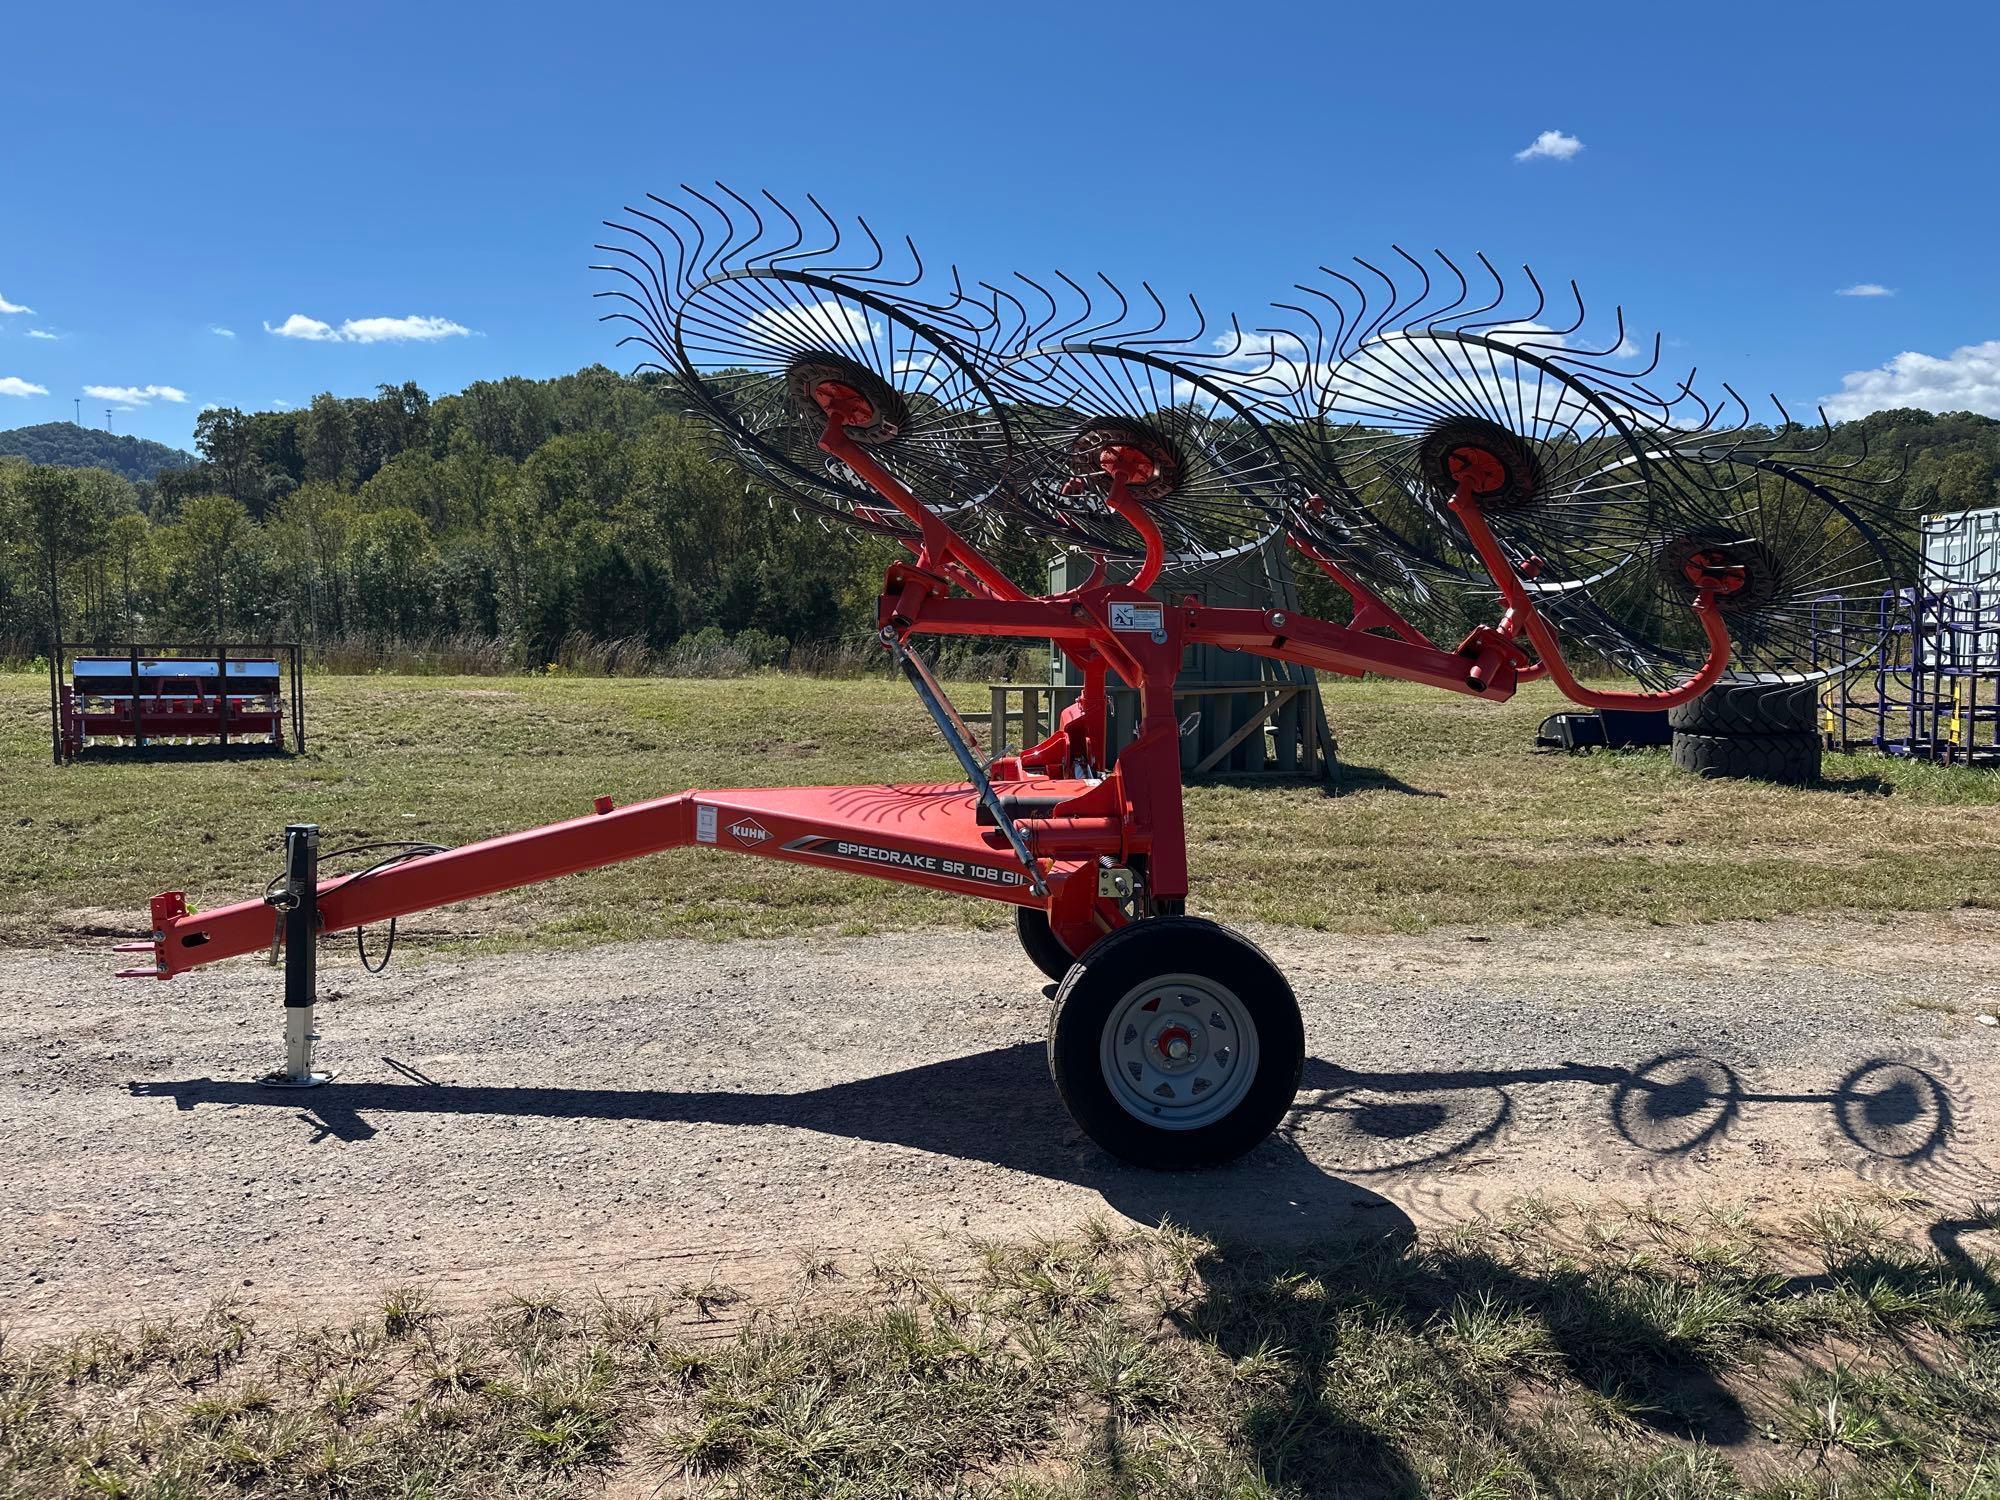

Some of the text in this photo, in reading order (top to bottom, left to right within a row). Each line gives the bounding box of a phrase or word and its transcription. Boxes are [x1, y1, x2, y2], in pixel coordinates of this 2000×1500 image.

[732, 825, 766, 840] KUHN
[837, 842, 1024, 885] SPEEDRAKE SR 108 GII
